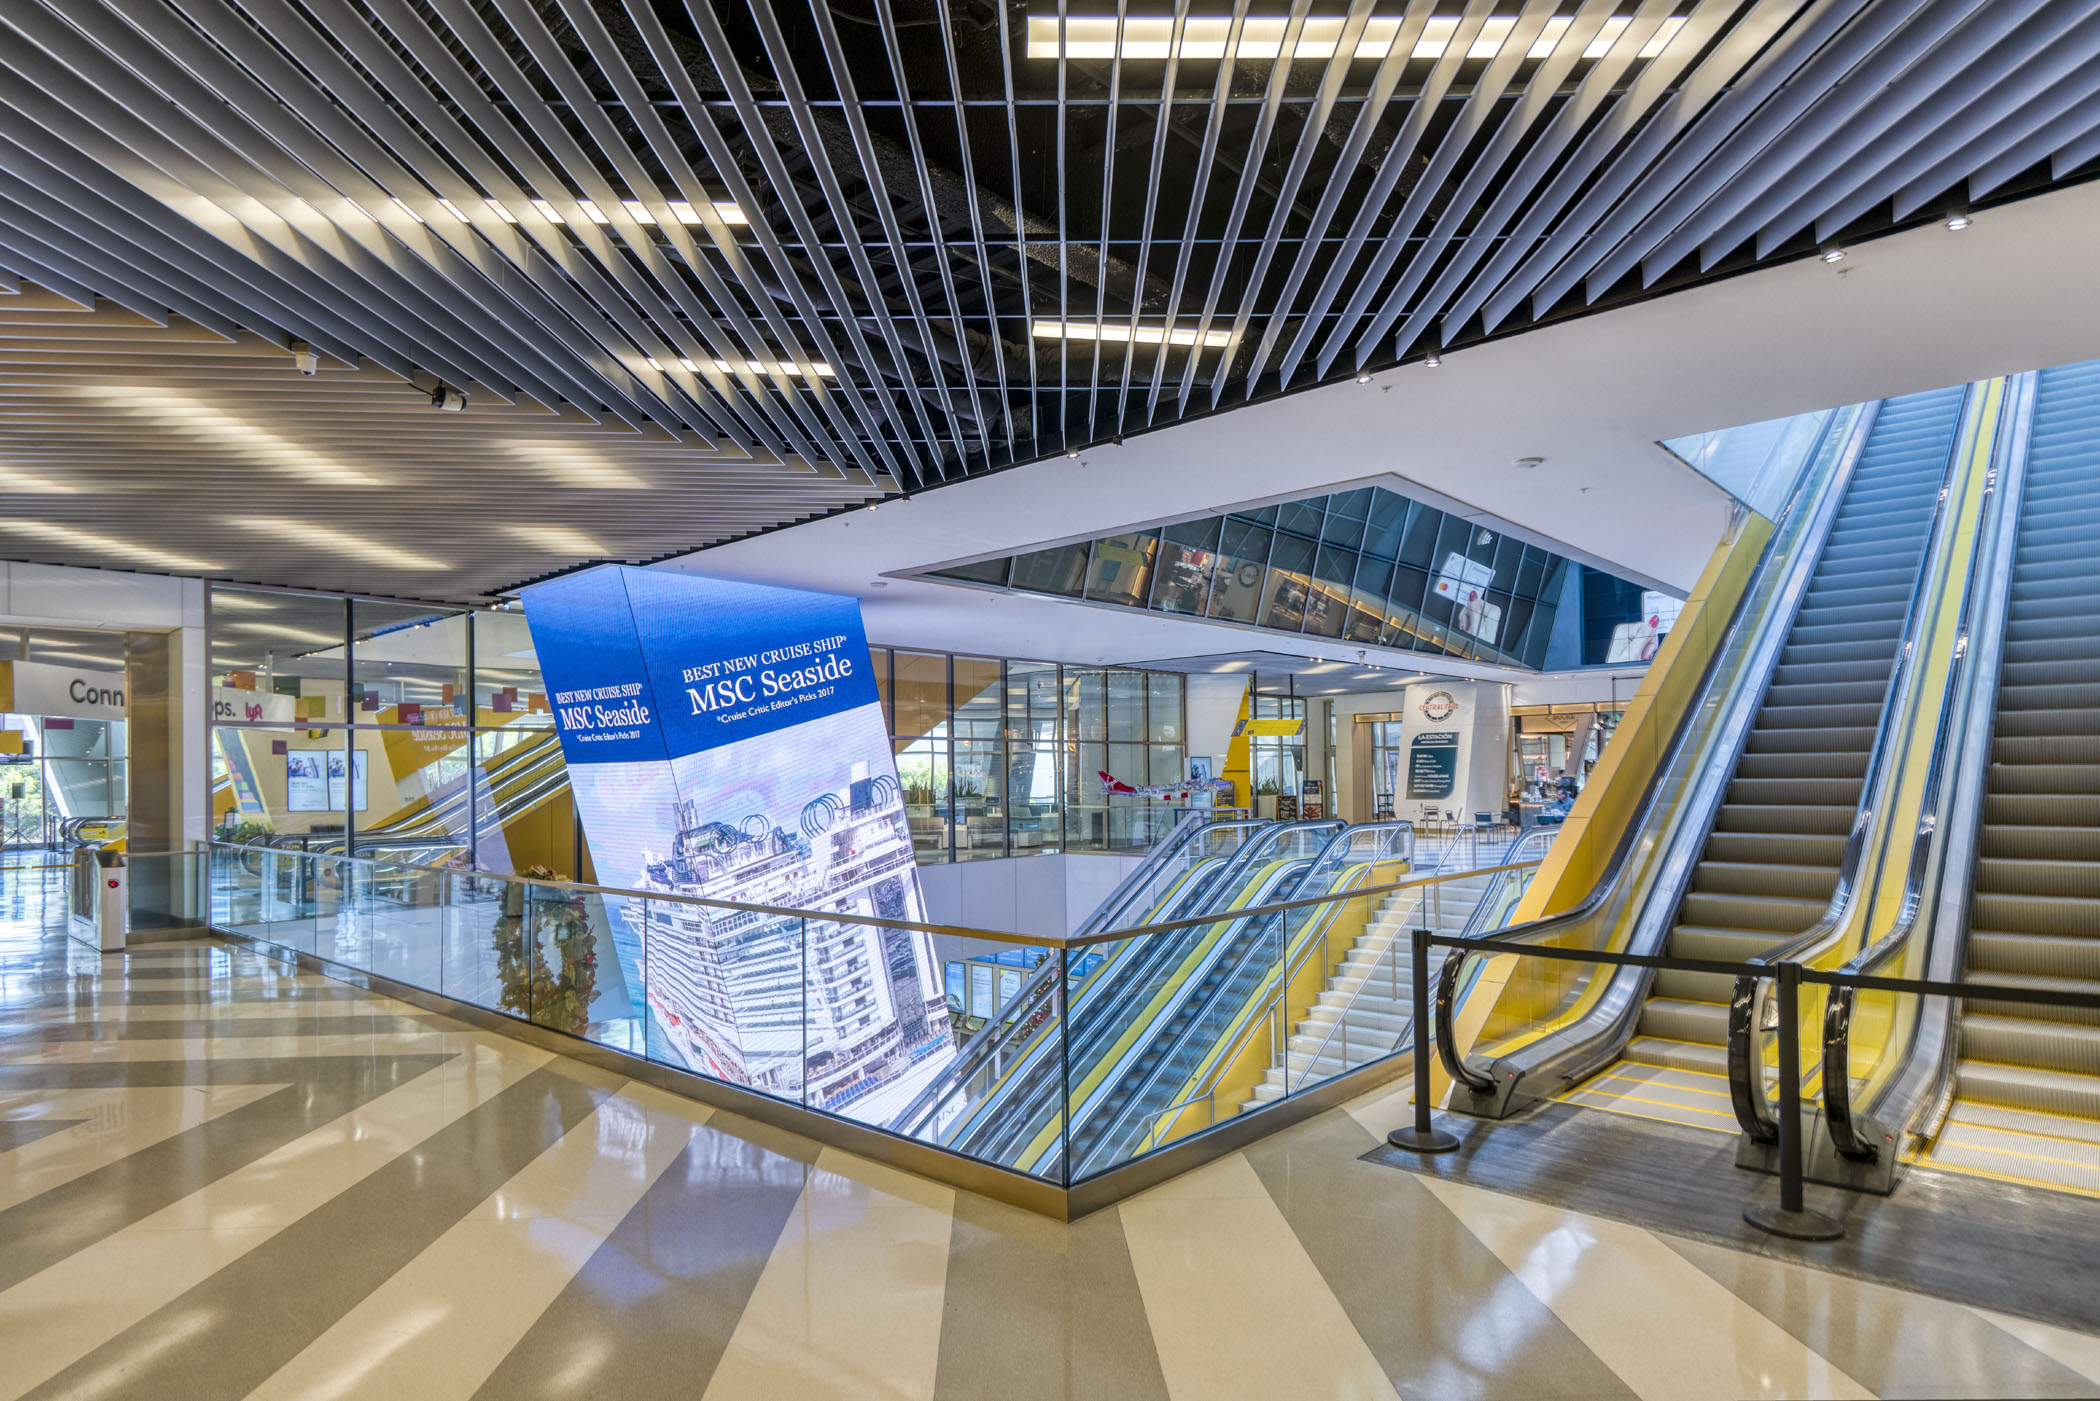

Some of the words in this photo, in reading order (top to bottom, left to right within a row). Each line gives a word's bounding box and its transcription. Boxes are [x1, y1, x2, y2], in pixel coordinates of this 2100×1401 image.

[682, 662, 721, 683] BEST
[723, 654, 758, 675] NEW
[761, 642, 812, 665] CRUISE
[555, 691, 574, 704] BEST
[574, 689, 593, 702] NEW
[593, 685, 622, 700] CRUISE
[686, 675, 756, 716] MSC
[761, 653, 853, 697] Seaside
[559, 705, 595, 730] MSC
[595, 699, 651, 728] Seaside
[748, 705, 770, 717] Critic
[771, 697, 798, 711] Editor's
[799, 693, 817, 704] Picks
[818, 686, 835, 698] 2017
